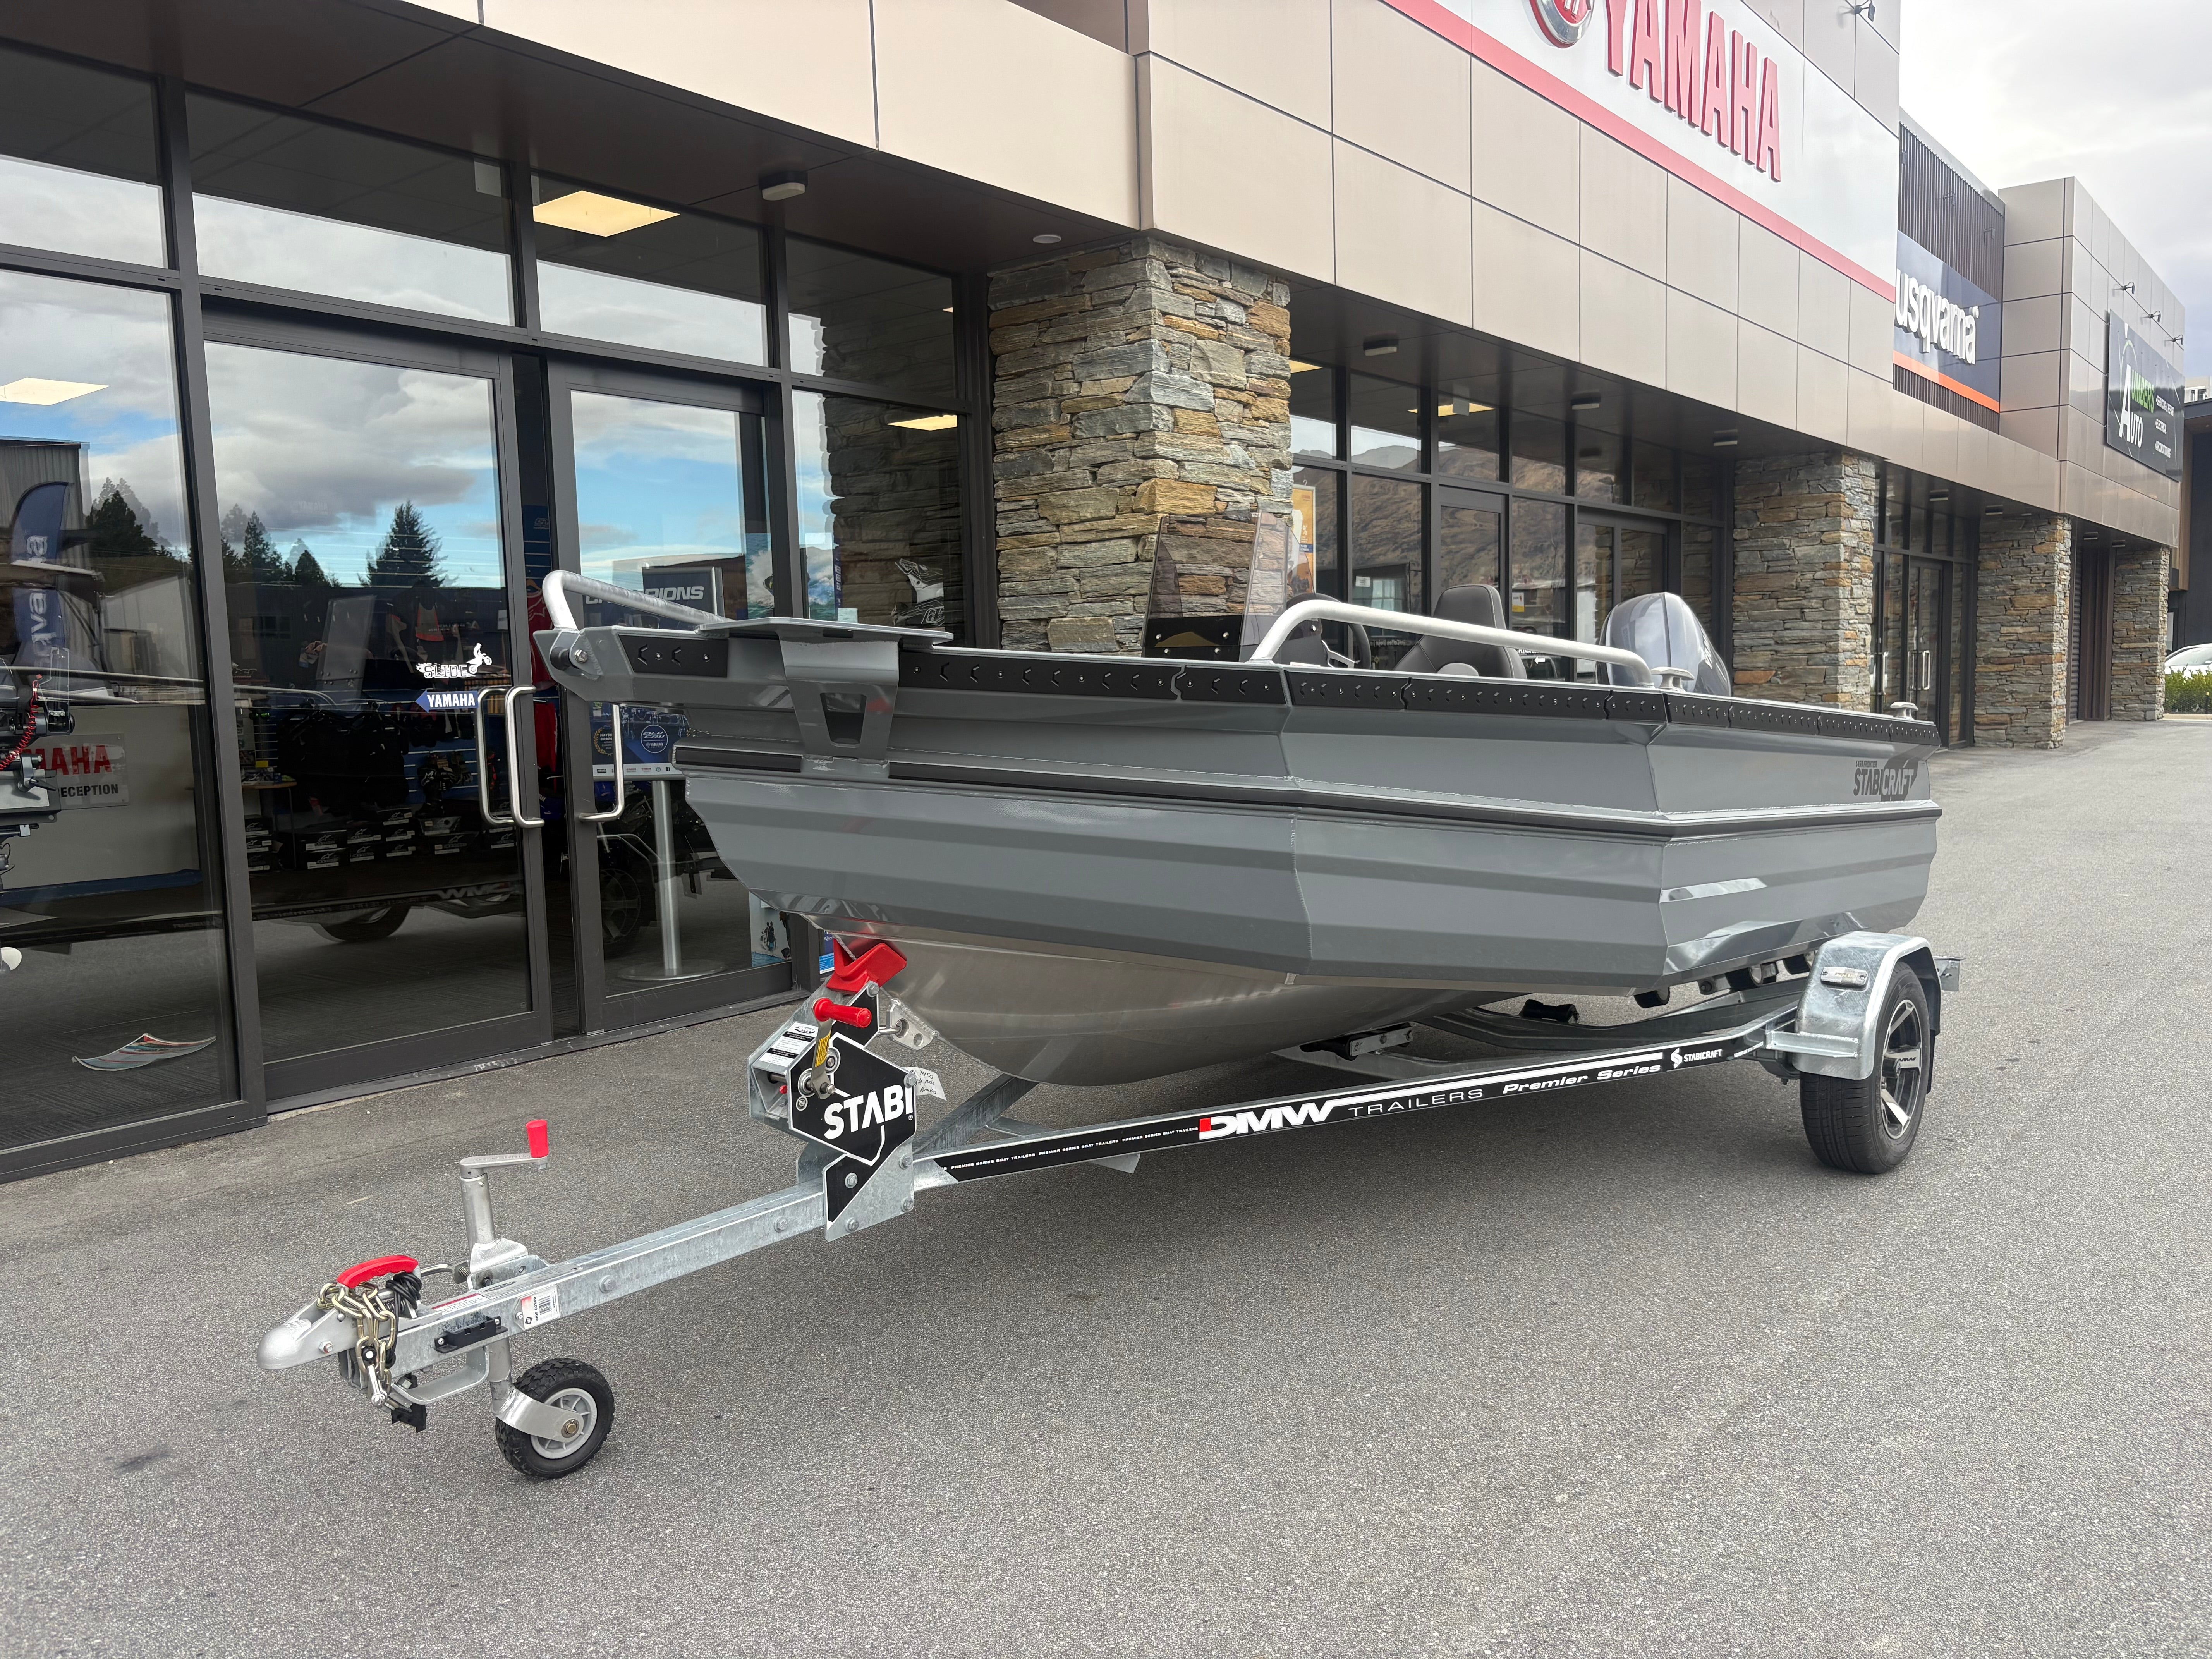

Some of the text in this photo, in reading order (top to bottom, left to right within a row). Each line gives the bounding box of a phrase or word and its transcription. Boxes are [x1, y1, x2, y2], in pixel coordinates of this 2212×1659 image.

[1604, 0, 1781, 182] YAMAHA
[1896, 268, 1976, 365] usqvarna
[424, 664, 467, 678] SLIDE
[427, 693, 476, 708] YAMAHA
[23, 745, 112, 775] MAHA
[58, 784, 118, 797] ECEPTION
[1853, 768, 1915, 796] STABICRAFT
[1683, 1049, 1722, 1062] STABICRAFT
[1502, 1063, 1661, 1094] Premier Series
[824, 1085, 914, 1139] STABI
[1348, 1089, 1483, 1117] TRAILERS
